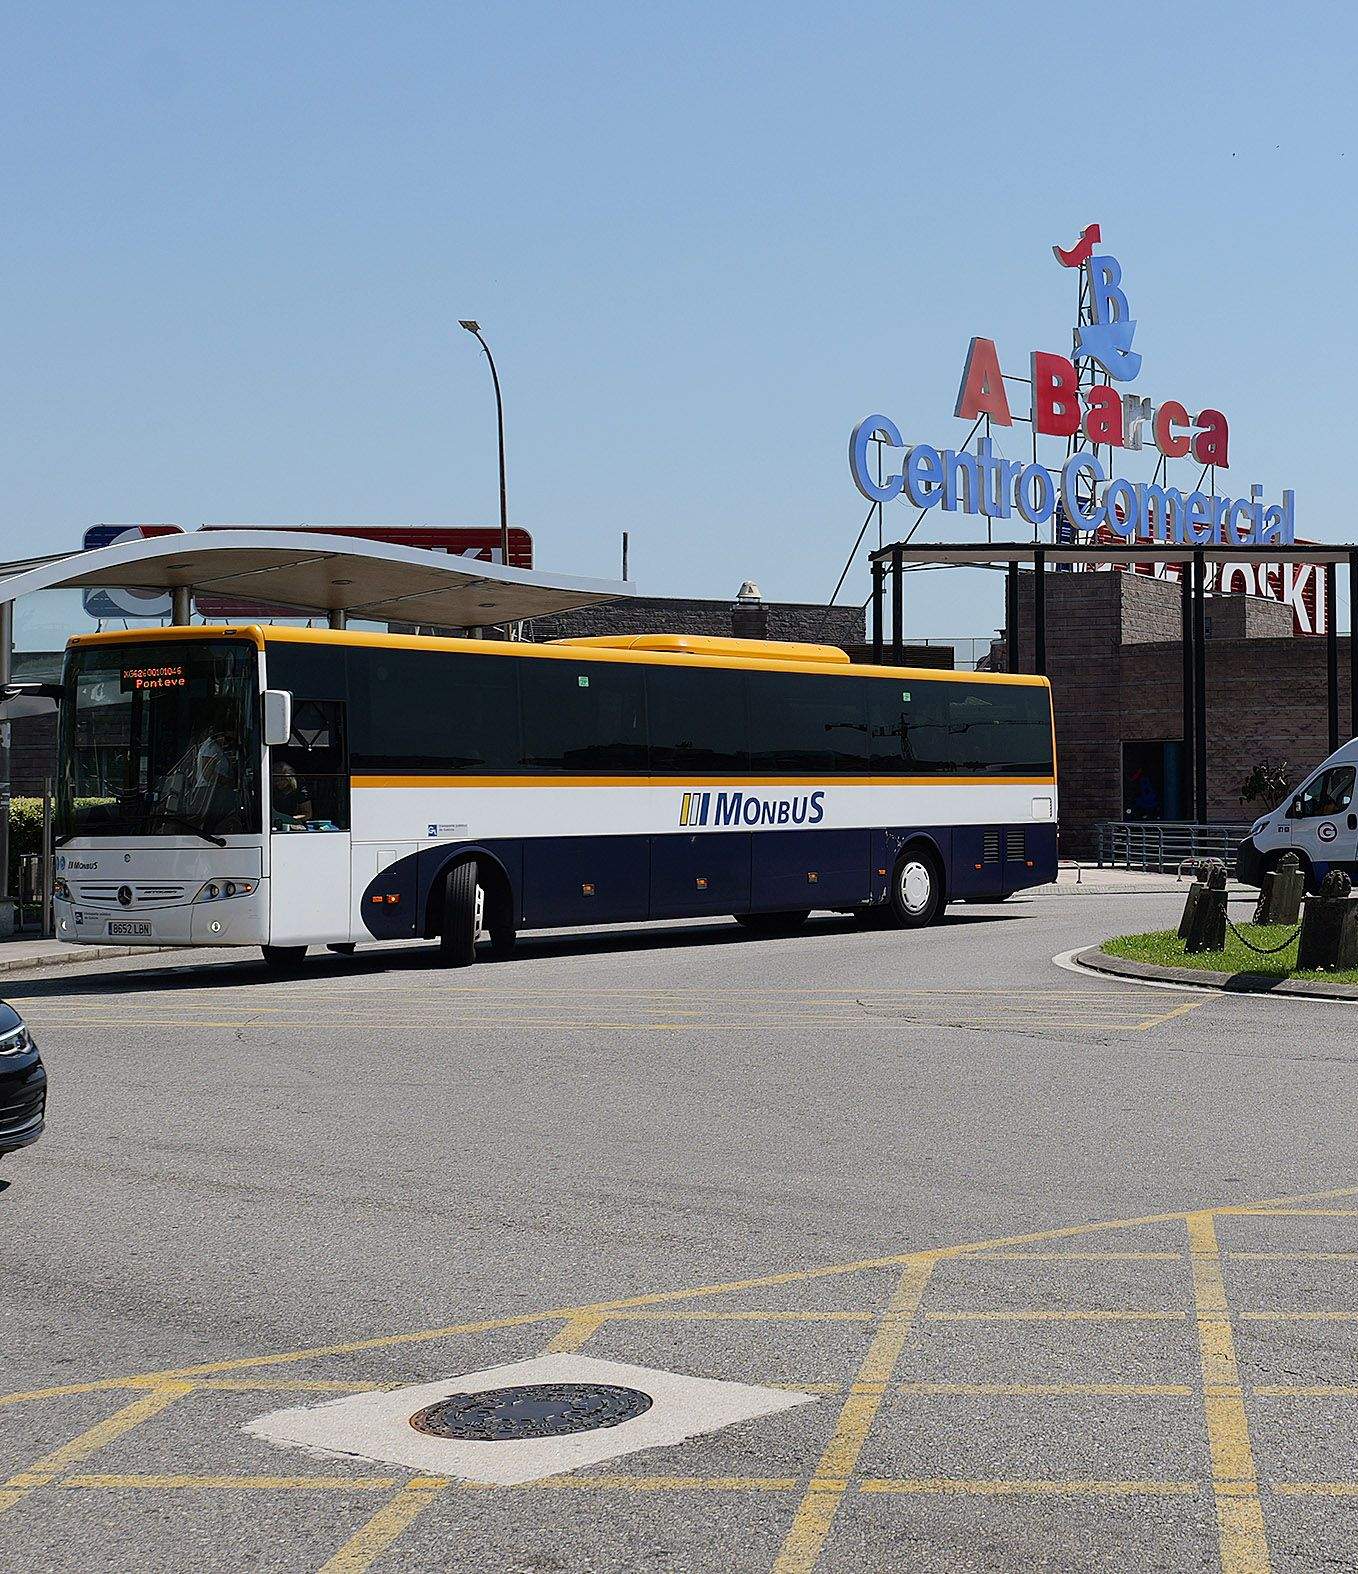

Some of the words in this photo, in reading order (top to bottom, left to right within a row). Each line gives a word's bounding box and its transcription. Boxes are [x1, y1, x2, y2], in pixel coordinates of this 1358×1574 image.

[954, 336, 1013, 427] A
[1030, 350, 1230, 468] Barca
[849, 414, 1055, 524] Centro
[1060, 452, 1295, 544] Comercial
[136, 679, 185, 688] Ponteve
